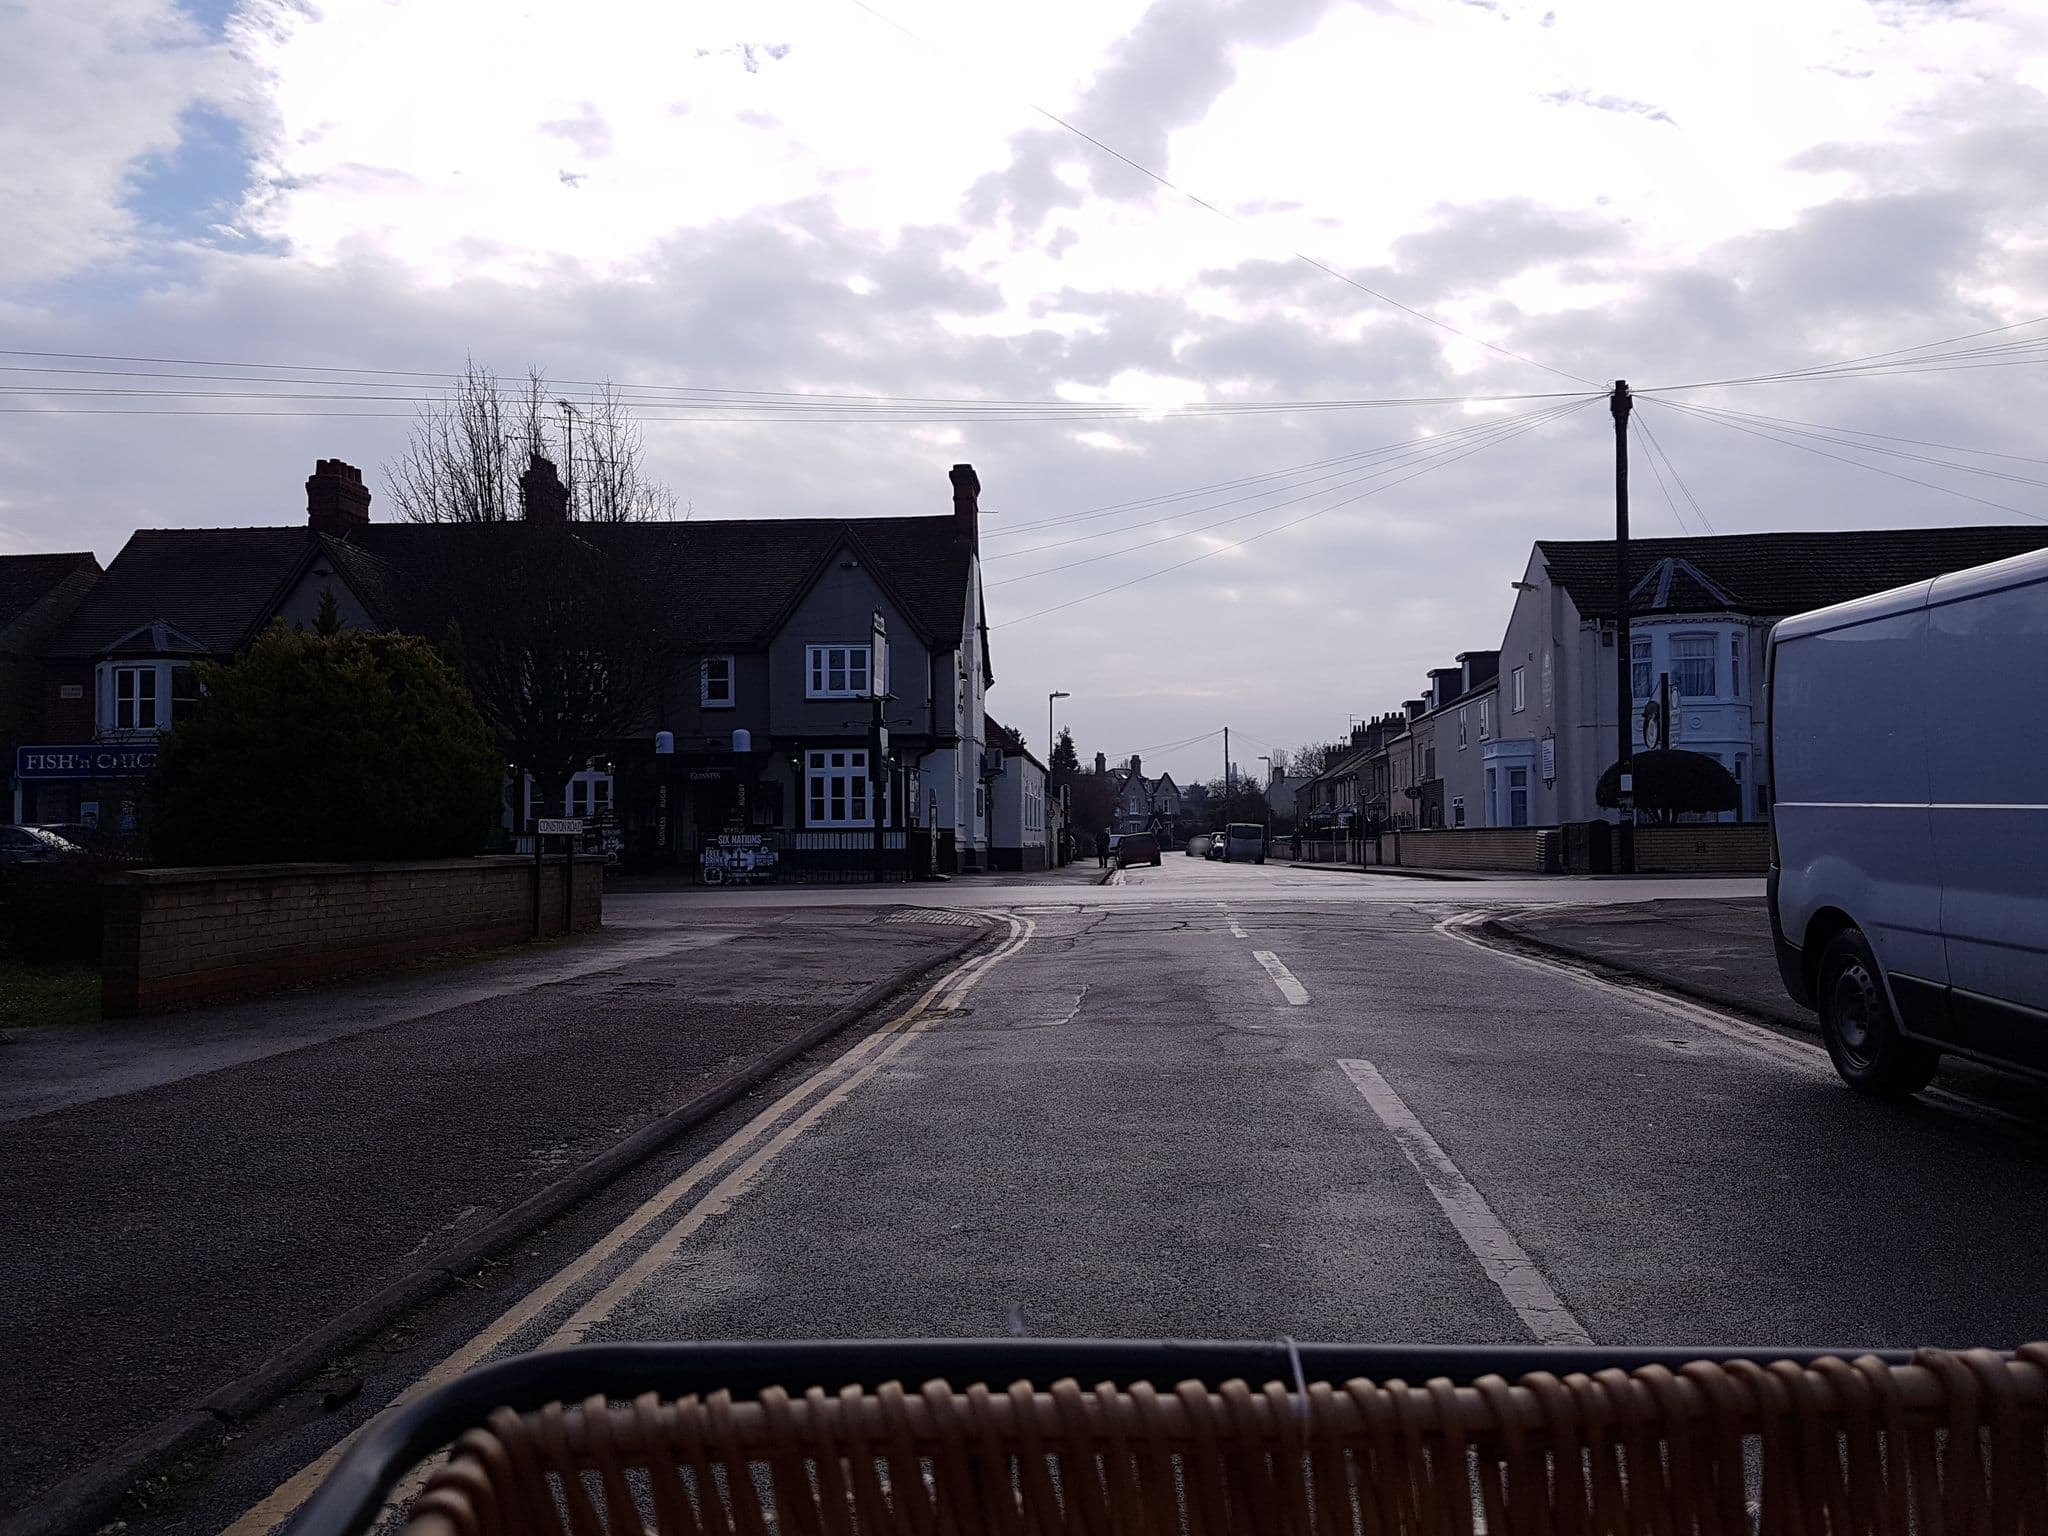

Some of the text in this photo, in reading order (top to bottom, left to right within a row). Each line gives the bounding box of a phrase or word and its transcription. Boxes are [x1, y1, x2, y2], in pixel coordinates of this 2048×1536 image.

[26, 754, 73, 769] FISH
[718, 834, 762, 845] SIX NATIONS
